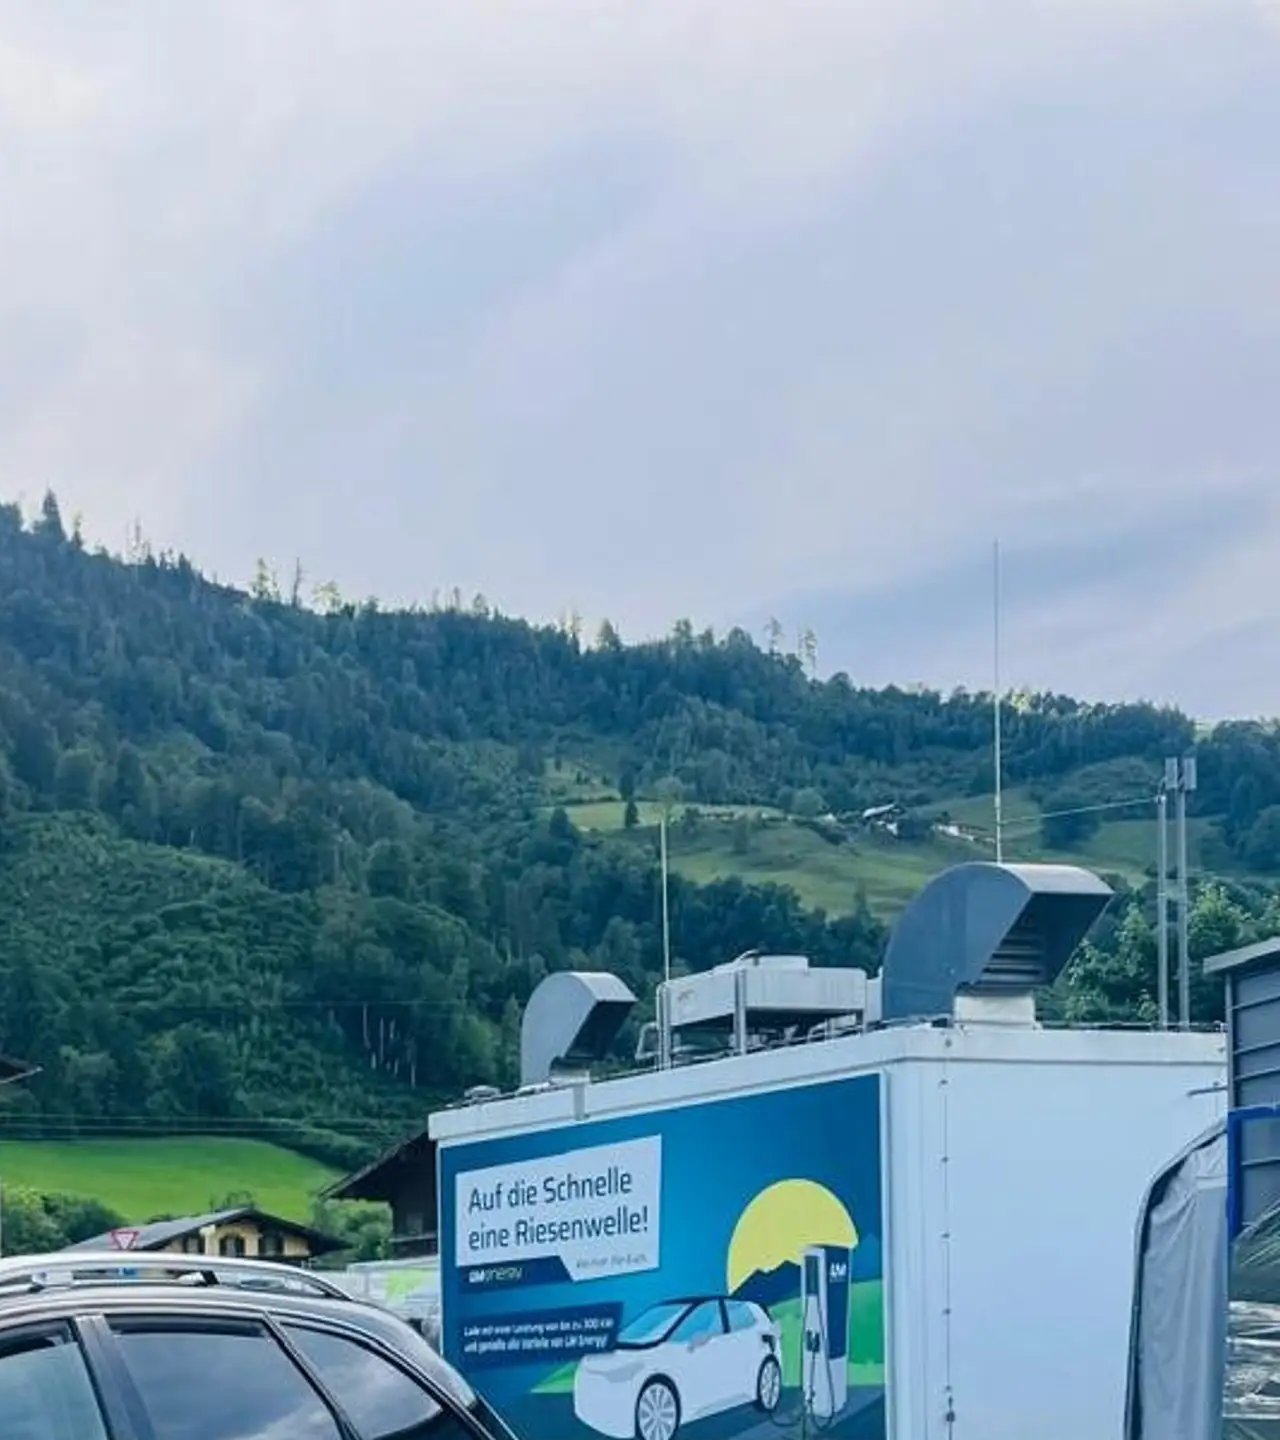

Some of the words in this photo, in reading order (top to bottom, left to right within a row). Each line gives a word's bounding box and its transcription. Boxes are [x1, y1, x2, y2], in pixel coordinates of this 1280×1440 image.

[469, 1182, 502, 1215] Auf
[507, 1179, 537, 1208] die
[543, 1165, 632, 1203] Schnelle
[469, 1222, 509, 1250] eine
[515, 1205, 648, 1246] Riesenwelle!
